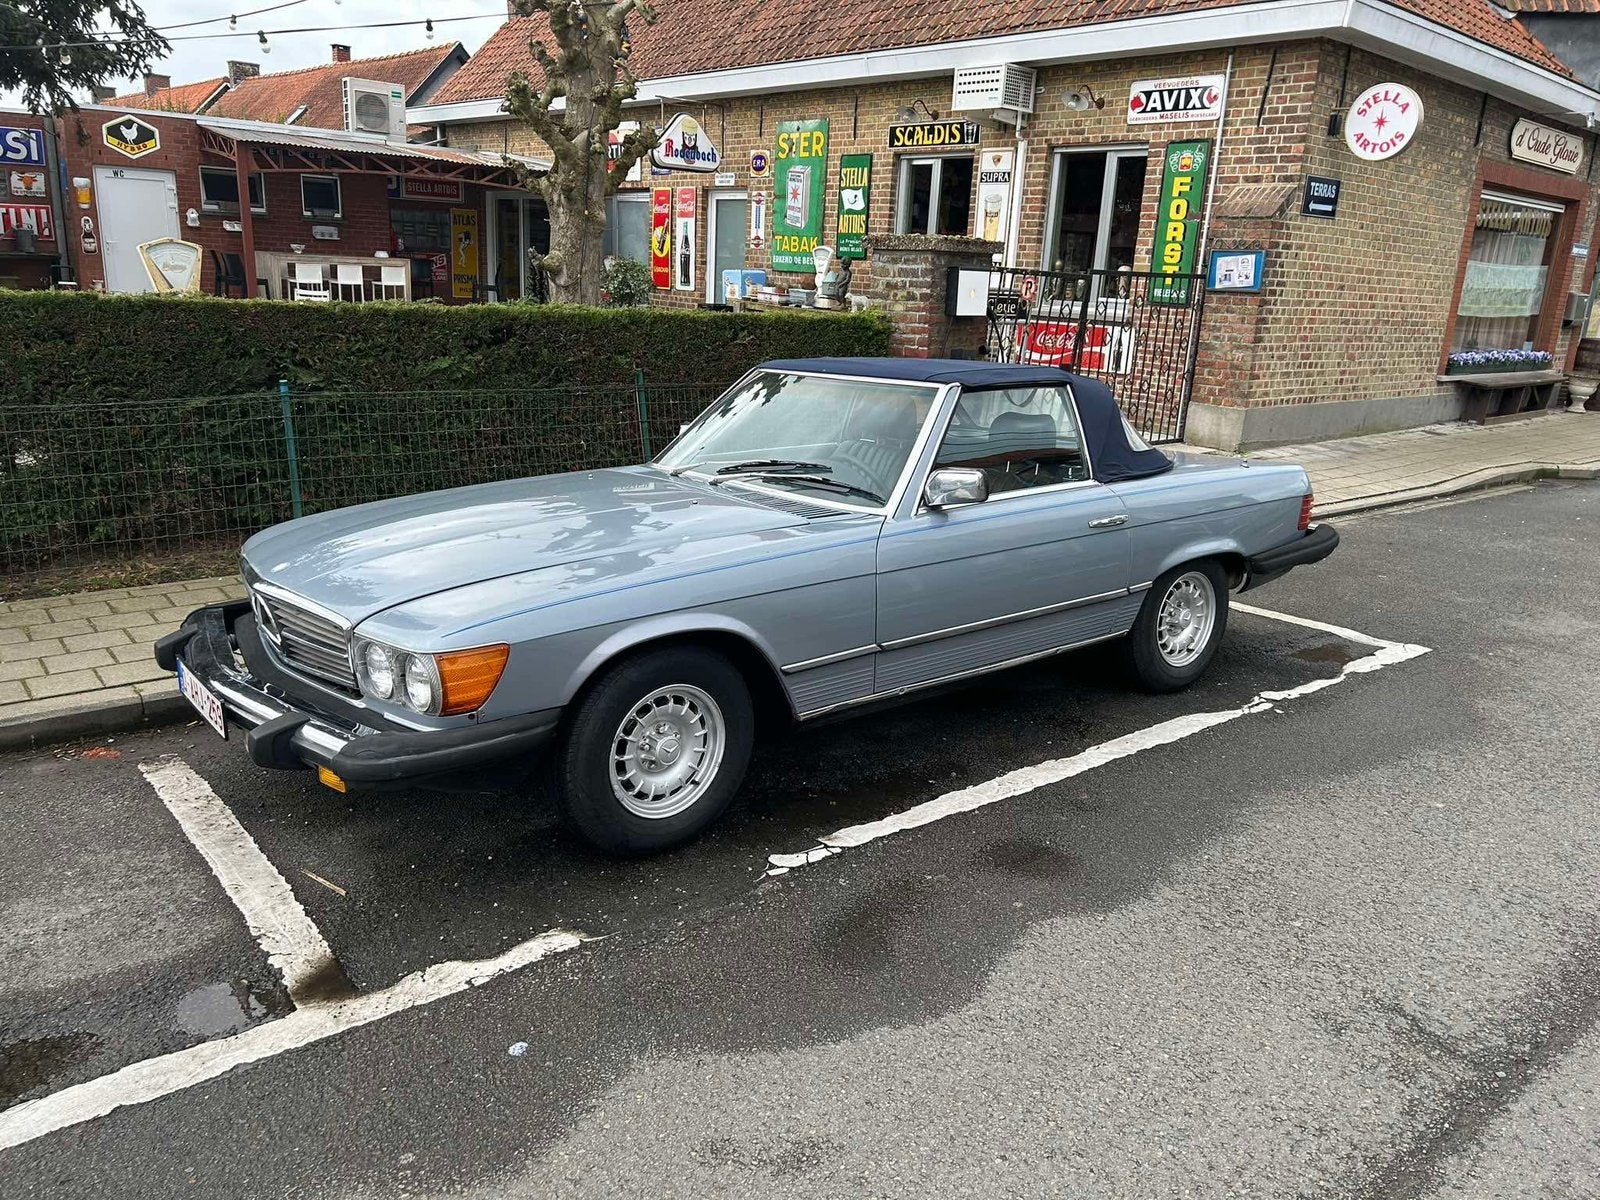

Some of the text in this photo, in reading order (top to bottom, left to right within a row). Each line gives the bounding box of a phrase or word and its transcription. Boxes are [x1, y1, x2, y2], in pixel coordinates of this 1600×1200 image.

[1153, 80, 1200, 89] VEEVOEDERS
[1145, 88, 1204, 112] AVIX
[1357, 90, 1410, 117] STELLA
[1159, 112, 1190, 120] MASELIS
[894, 123, 961, 146] SCALDIS
[1353, 131, 1405, 153] ARTOIS
[117, 141, 148, 152] HYBRO
[664, 138, 717, 163] Rodenbach
[777, 131, 825, 159] STER
[1527, 127, 1551, 155] Oude
[1550, 134, 1579, 164] Glorie
[112, 169, 125, 178] WC
[752, 159, 765, 168] ERA
[840, 167, 868, 187] STELLA
[981, 172, 1009, 183] SUPRA
[407, 182, 432, 193] STELLA
[1310, 181, 1336, 198] TERRAS
[838, 214, 866, 234] ARTOIS
[1161, 176, 1192, 285] FORST
[774, 235, 818, 252] TABAK
